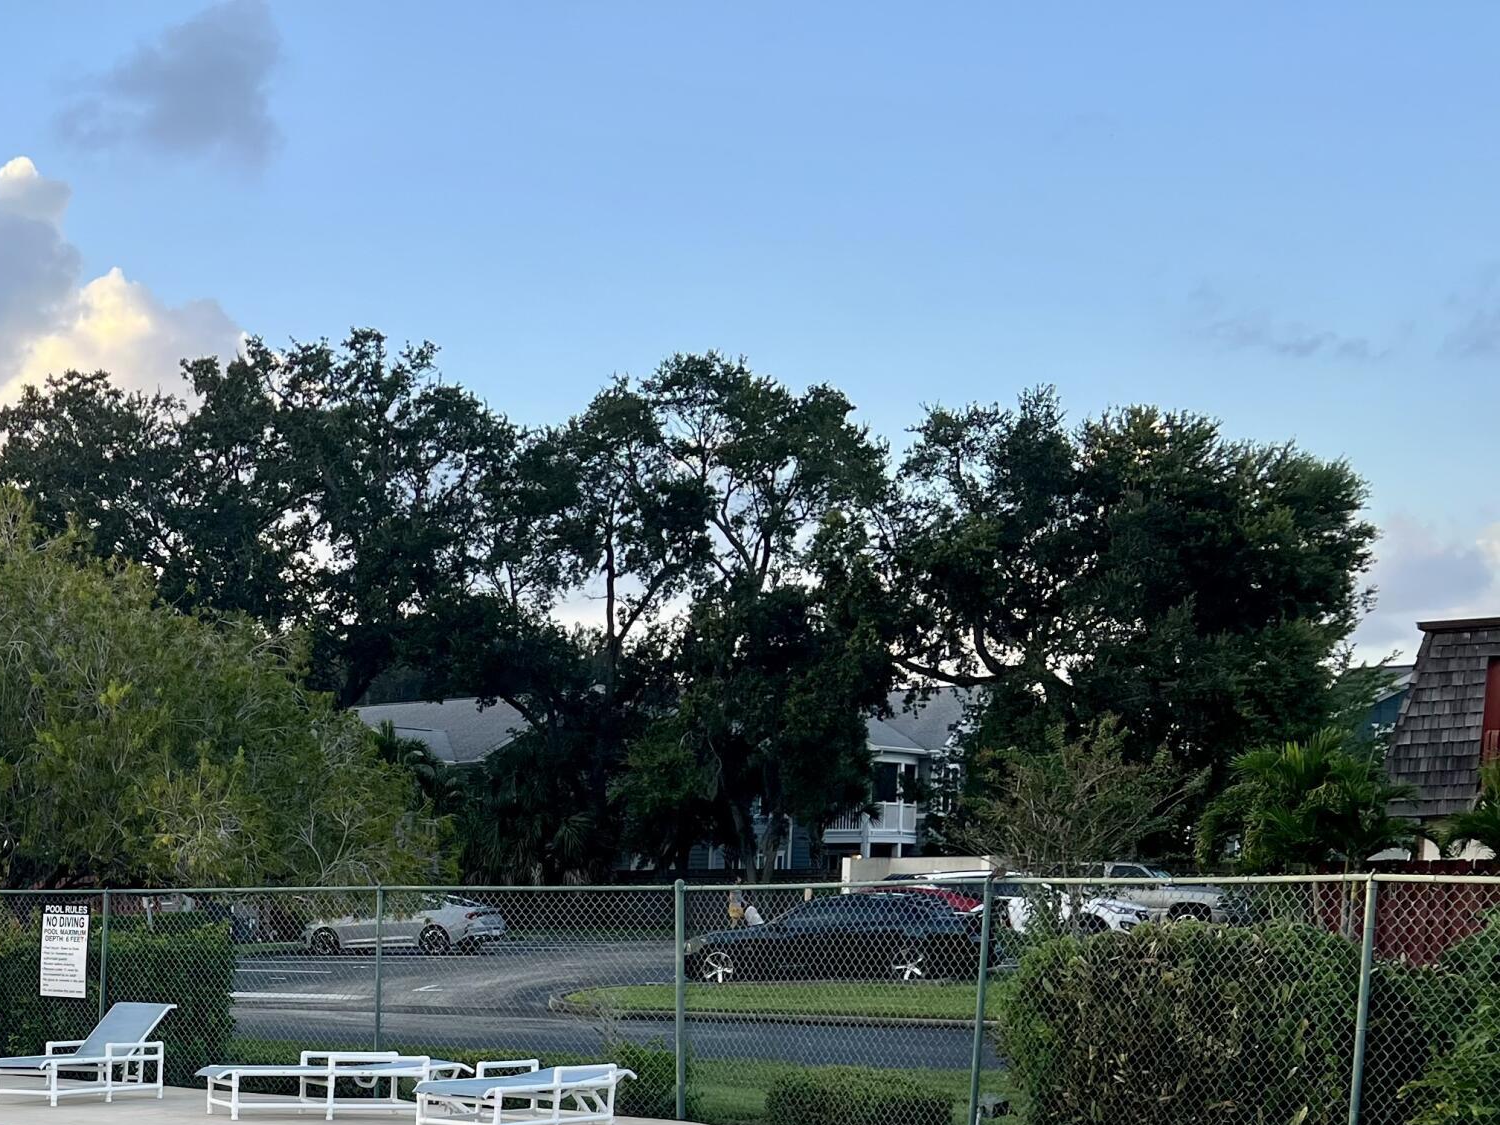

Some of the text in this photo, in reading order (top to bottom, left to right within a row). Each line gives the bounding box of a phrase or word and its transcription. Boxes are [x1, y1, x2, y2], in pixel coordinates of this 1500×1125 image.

[45, 905, 88, 914] POOL RULES
[46, 916, 85, 928] NO DIVING
